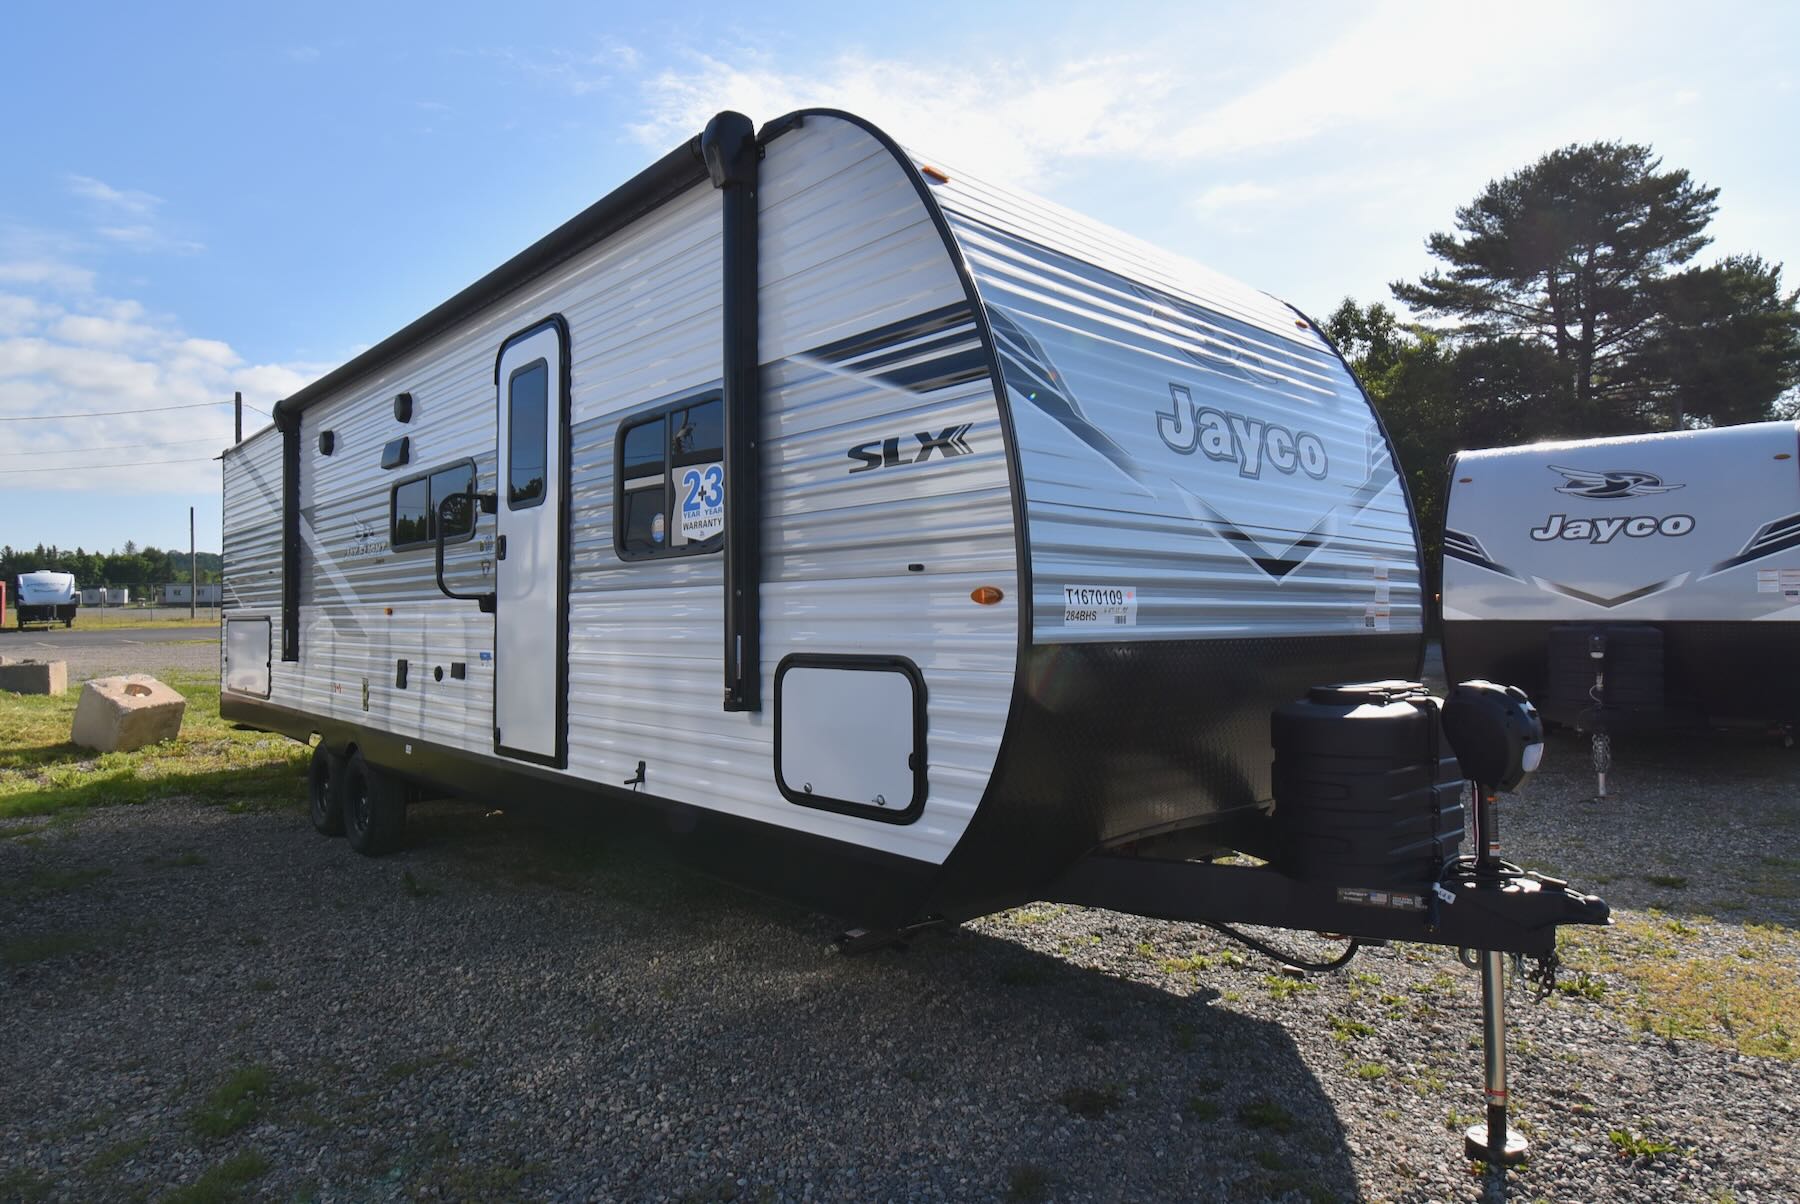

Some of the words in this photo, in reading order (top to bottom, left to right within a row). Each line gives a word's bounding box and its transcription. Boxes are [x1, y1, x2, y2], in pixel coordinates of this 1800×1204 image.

[1155, 382, 1328, 480] Jayco
[847, 422, 974, 474] SLX
[683, 510, 701, 519] YEAR
[704, 506, 723, 516] YEAR
[682, 518, 722, 531] WARRANTY
[1530, 514, 1696, 544] Jayco
[1065, 588, 1124, 605] T1670109
[1065, 610, 1098, 621] 284BHS
